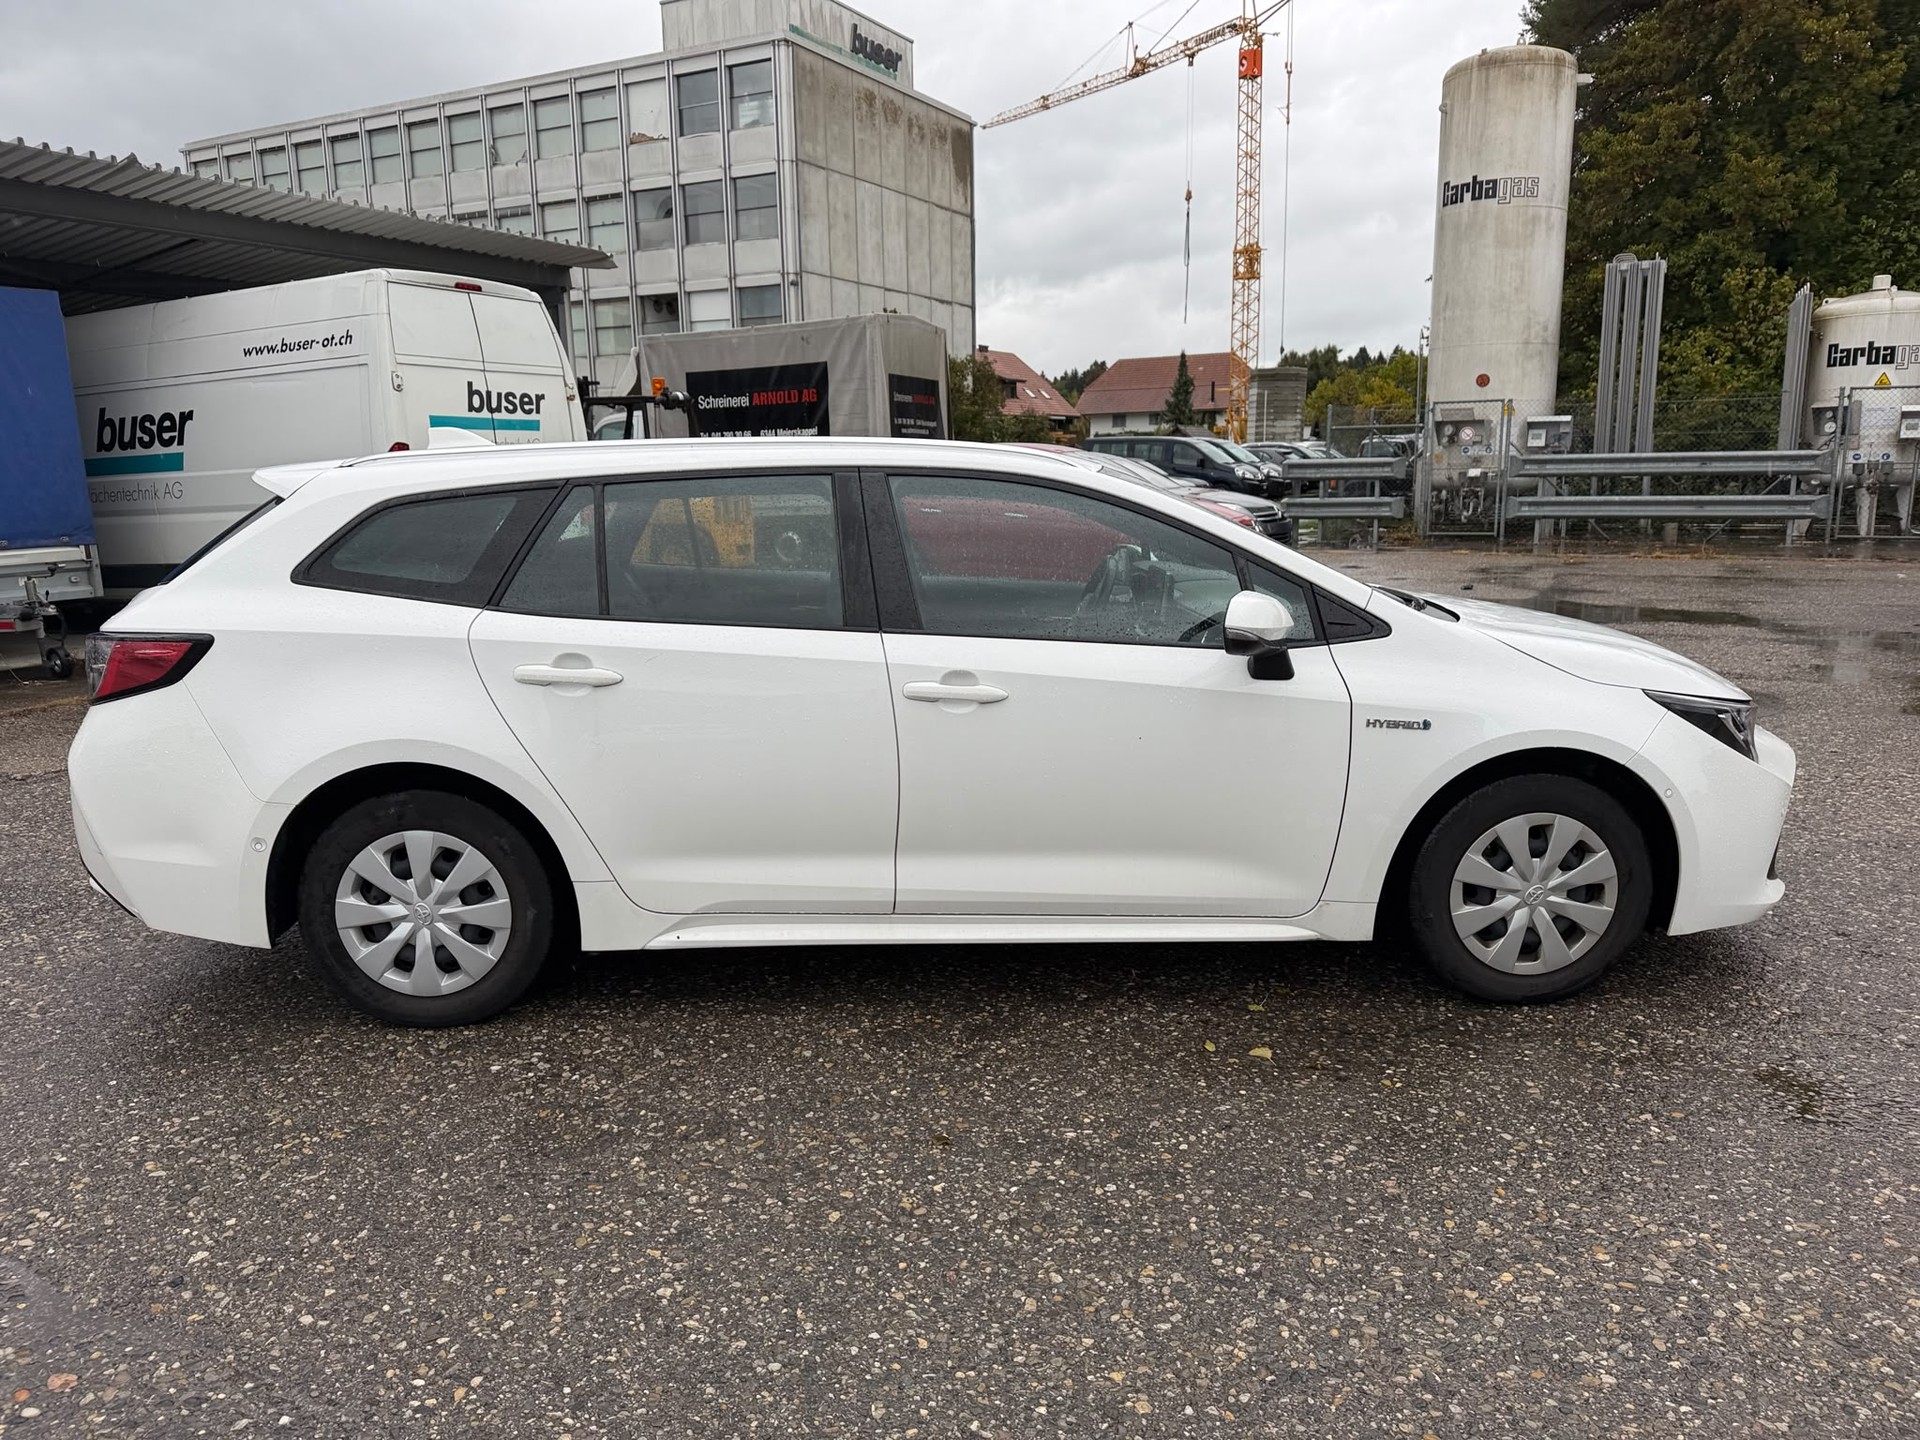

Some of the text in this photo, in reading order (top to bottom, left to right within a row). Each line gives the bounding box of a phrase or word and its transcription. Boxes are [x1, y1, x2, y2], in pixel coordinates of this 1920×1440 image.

[850, 23, 902, 73] buser
[1442, 175, 1540, 208] Carbagas
[243, 329, 353, 358] www.buser-ot.ch
[467, 381, 545, 415] buser
[698, 388, 817, 410] Schreinerei ARNOLD AG
[96, 407, 194, 453] buser
[163, 480, 184, 500] AG
[1366, 719, 1421, 730] HYBRID
